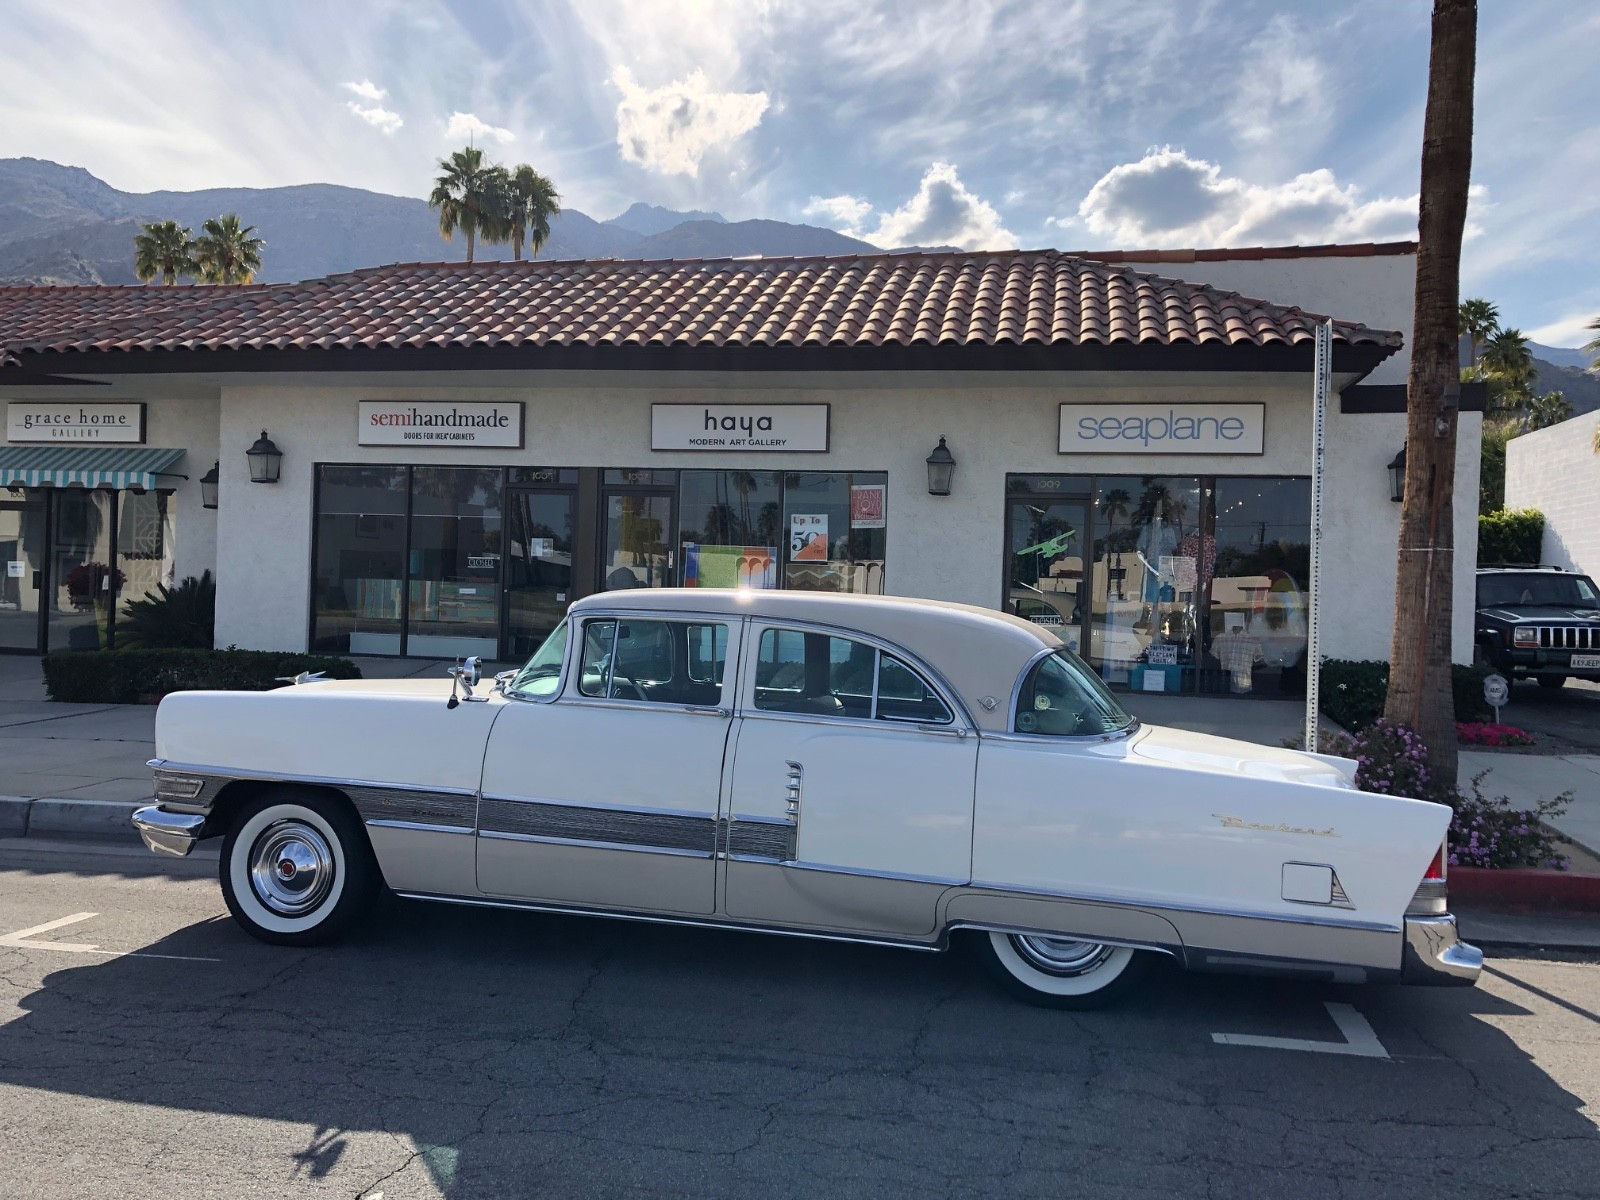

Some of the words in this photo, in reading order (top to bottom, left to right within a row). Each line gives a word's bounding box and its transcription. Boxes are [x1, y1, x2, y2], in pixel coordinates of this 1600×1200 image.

[24, 413, 71, 429] grace
[79, 409, 126, 424] home
[370, 408, 509, 428] semihandmade
[704, 409, 773, 437] haya
[52, 428, 99, 437] GALLERY
[1077, 409, 1245, 447] seaplane
[403, 432, 422, 440] DOORS
[423, 432, 435, 440] FOR
[449, 433, 475, 441] CABINETS
[689, 438, 725, 446] MODERN
[729, 438, 747, 446] ART
[793, 516, 805, 525] Up
[810, 516, 820, 524] To
[468, 558, 494, 567] CLOSED
[1030, 616, 1060, 625] CLOSED
